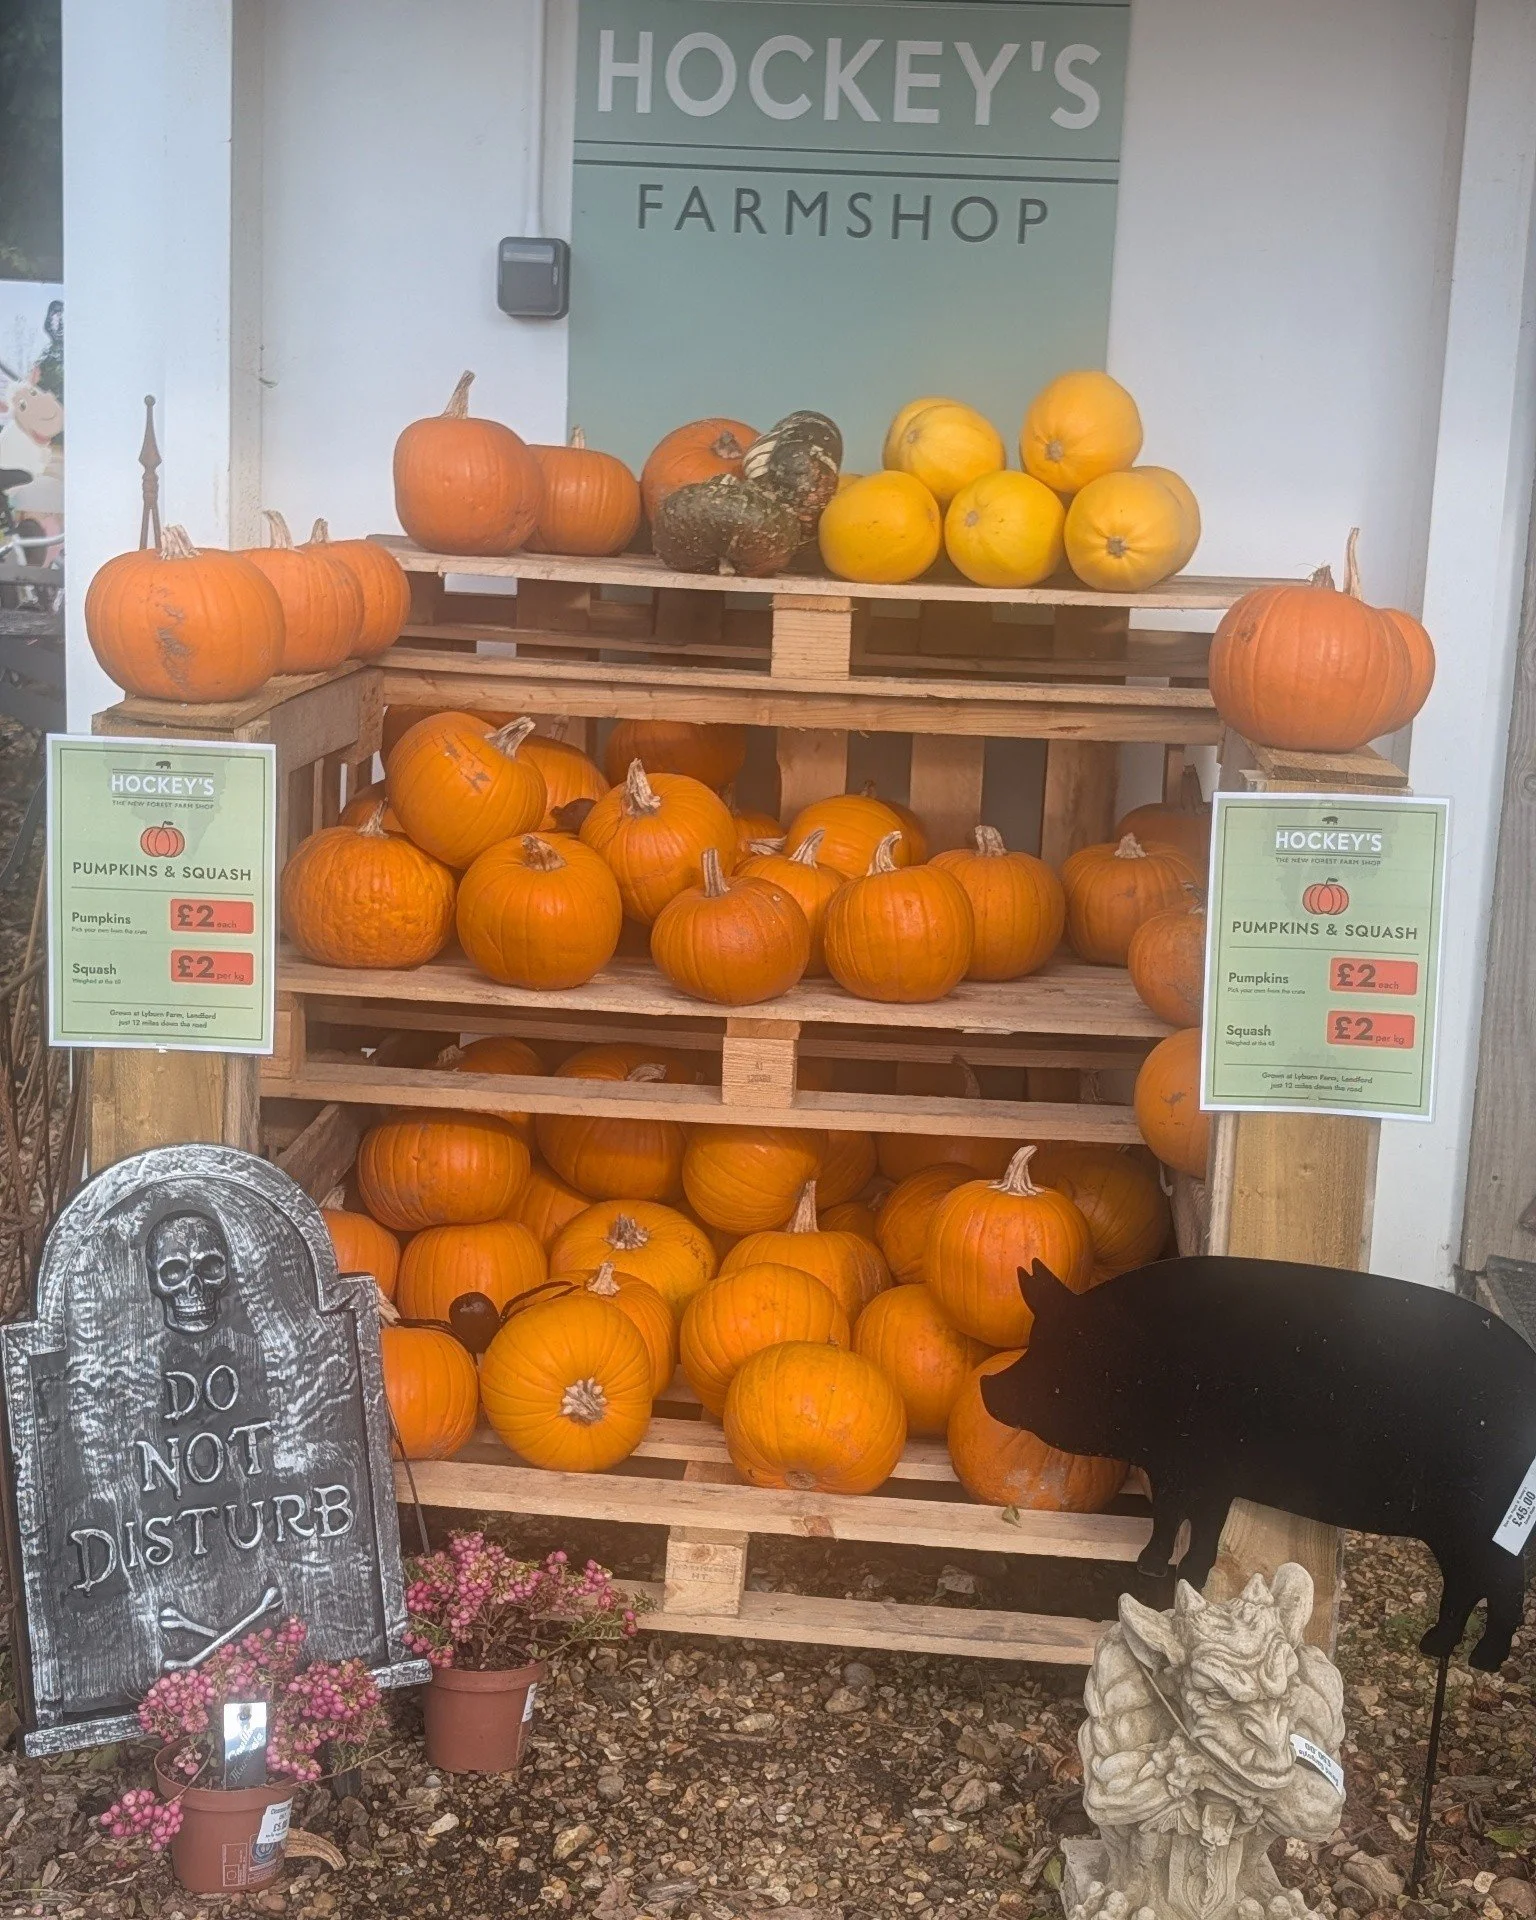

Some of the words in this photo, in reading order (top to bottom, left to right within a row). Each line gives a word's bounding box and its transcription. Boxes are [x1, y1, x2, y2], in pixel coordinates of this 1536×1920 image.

[597, 30, 1101, 130] HOCKEY'S
[637, 184, 1048, 244] FARMSHOP
[111, 774, 215, 796] HOCKEY'S
[1275, 831, 1382, 852] HOCKEY'S
[73, 862, 158, 877] PUMPKINS
[164, 866, 175, 878] &
[182, 866, 252, 880] SQUASH
[72, 912, 131, 926] Pumpkins
[177, 904, 215, 928] £2
[1232, 921, 1320, 935] PUMPKINS
[1326, 923, 1338, 936] &
[1344, 924, 1418, 940] SQUASH
[72, 963, 117, 977] Squash
[177, 955, 215, 979] £2
[234, 972, 245, 982] kg
[1228, 972, 1289, 986] Pumpkins
[1337, 963, 1376, 988] £2
[1378, 981, 1400, 990] each
[1226, 1024, 1272, 1038] Squash
[1335, 1016, 1374, 1041] £2
[1375, 1035, 1391, 1044] per
[1394, 1034, 1405, 1045] kg
[164, 1364, 240, 1419] DO
[135, 1421, 275, 1498] NOT
[1511, 1491, 1536, 1527] £45.00
[70, 1484, 354, 1593] DISTURB
